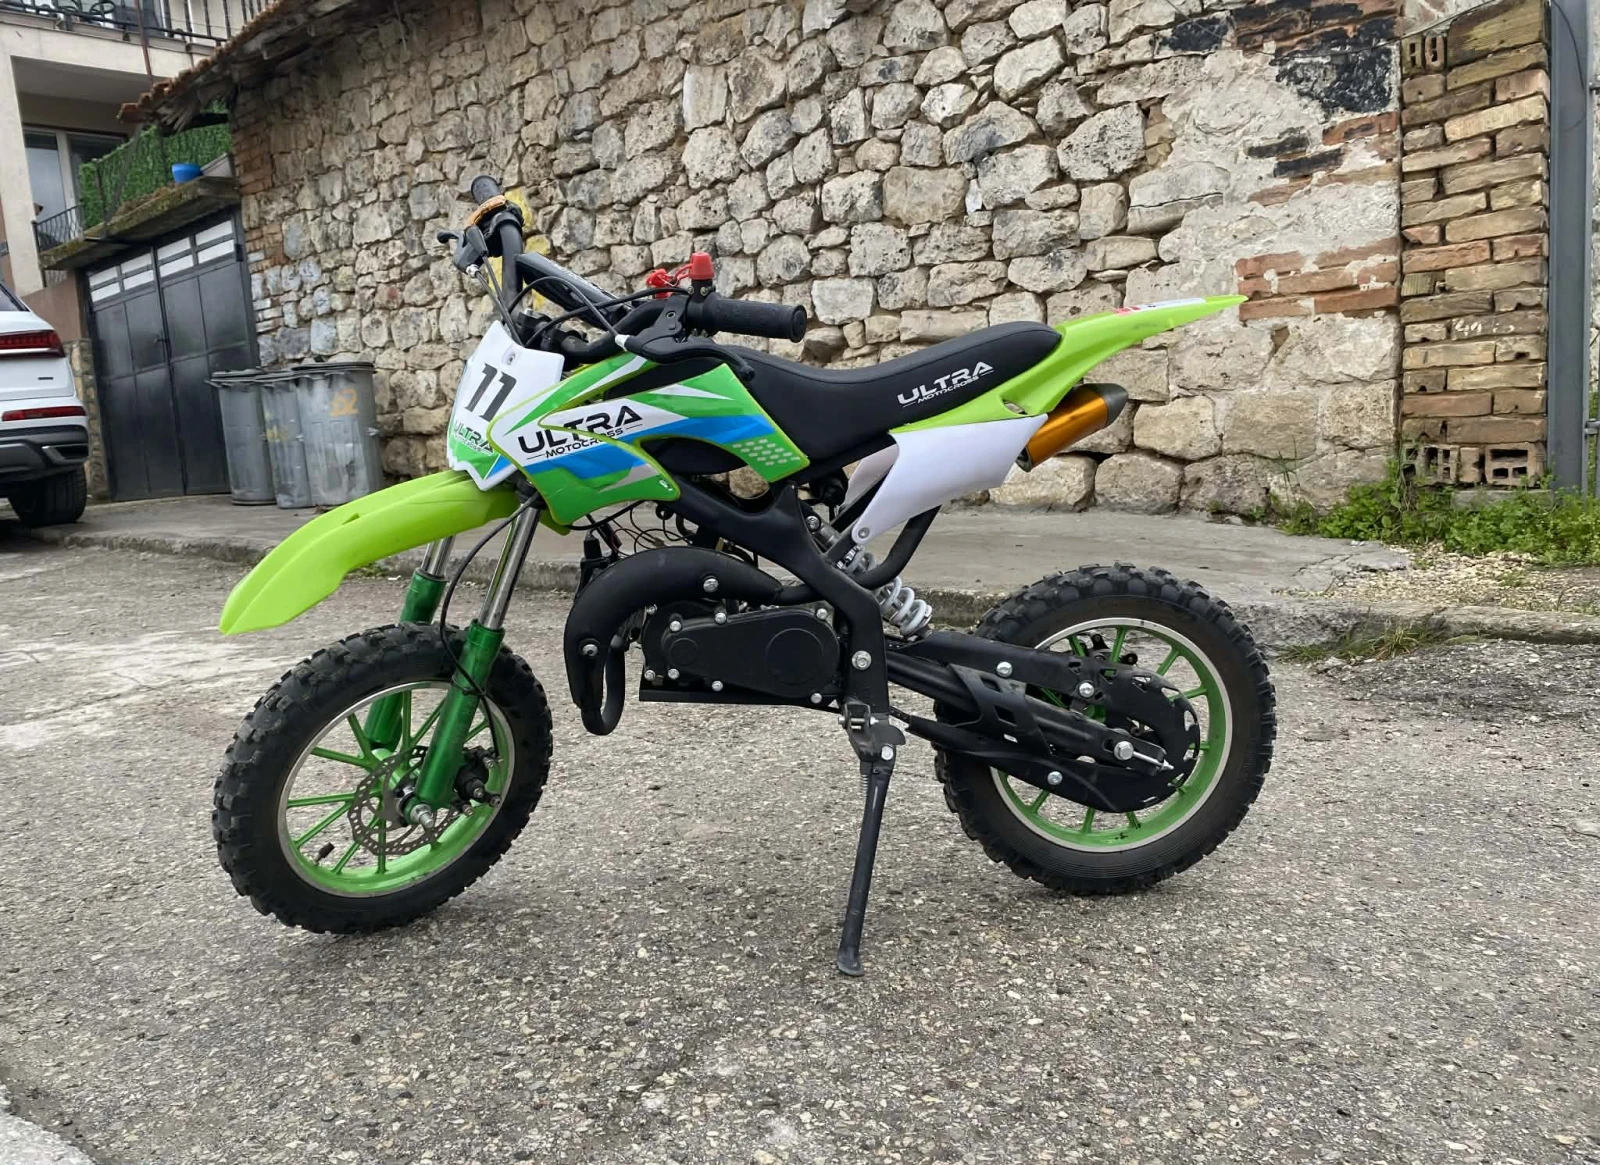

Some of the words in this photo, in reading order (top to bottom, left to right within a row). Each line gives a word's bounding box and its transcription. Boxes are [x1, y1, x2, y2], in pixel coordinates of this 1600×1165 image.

[464, 362, 517, 422] 11
[897, 361, 994, 404] ULTRA
[917, 375, 979, 404] MOTOCROSS
[517, 405, 643, 454] ULTRA
